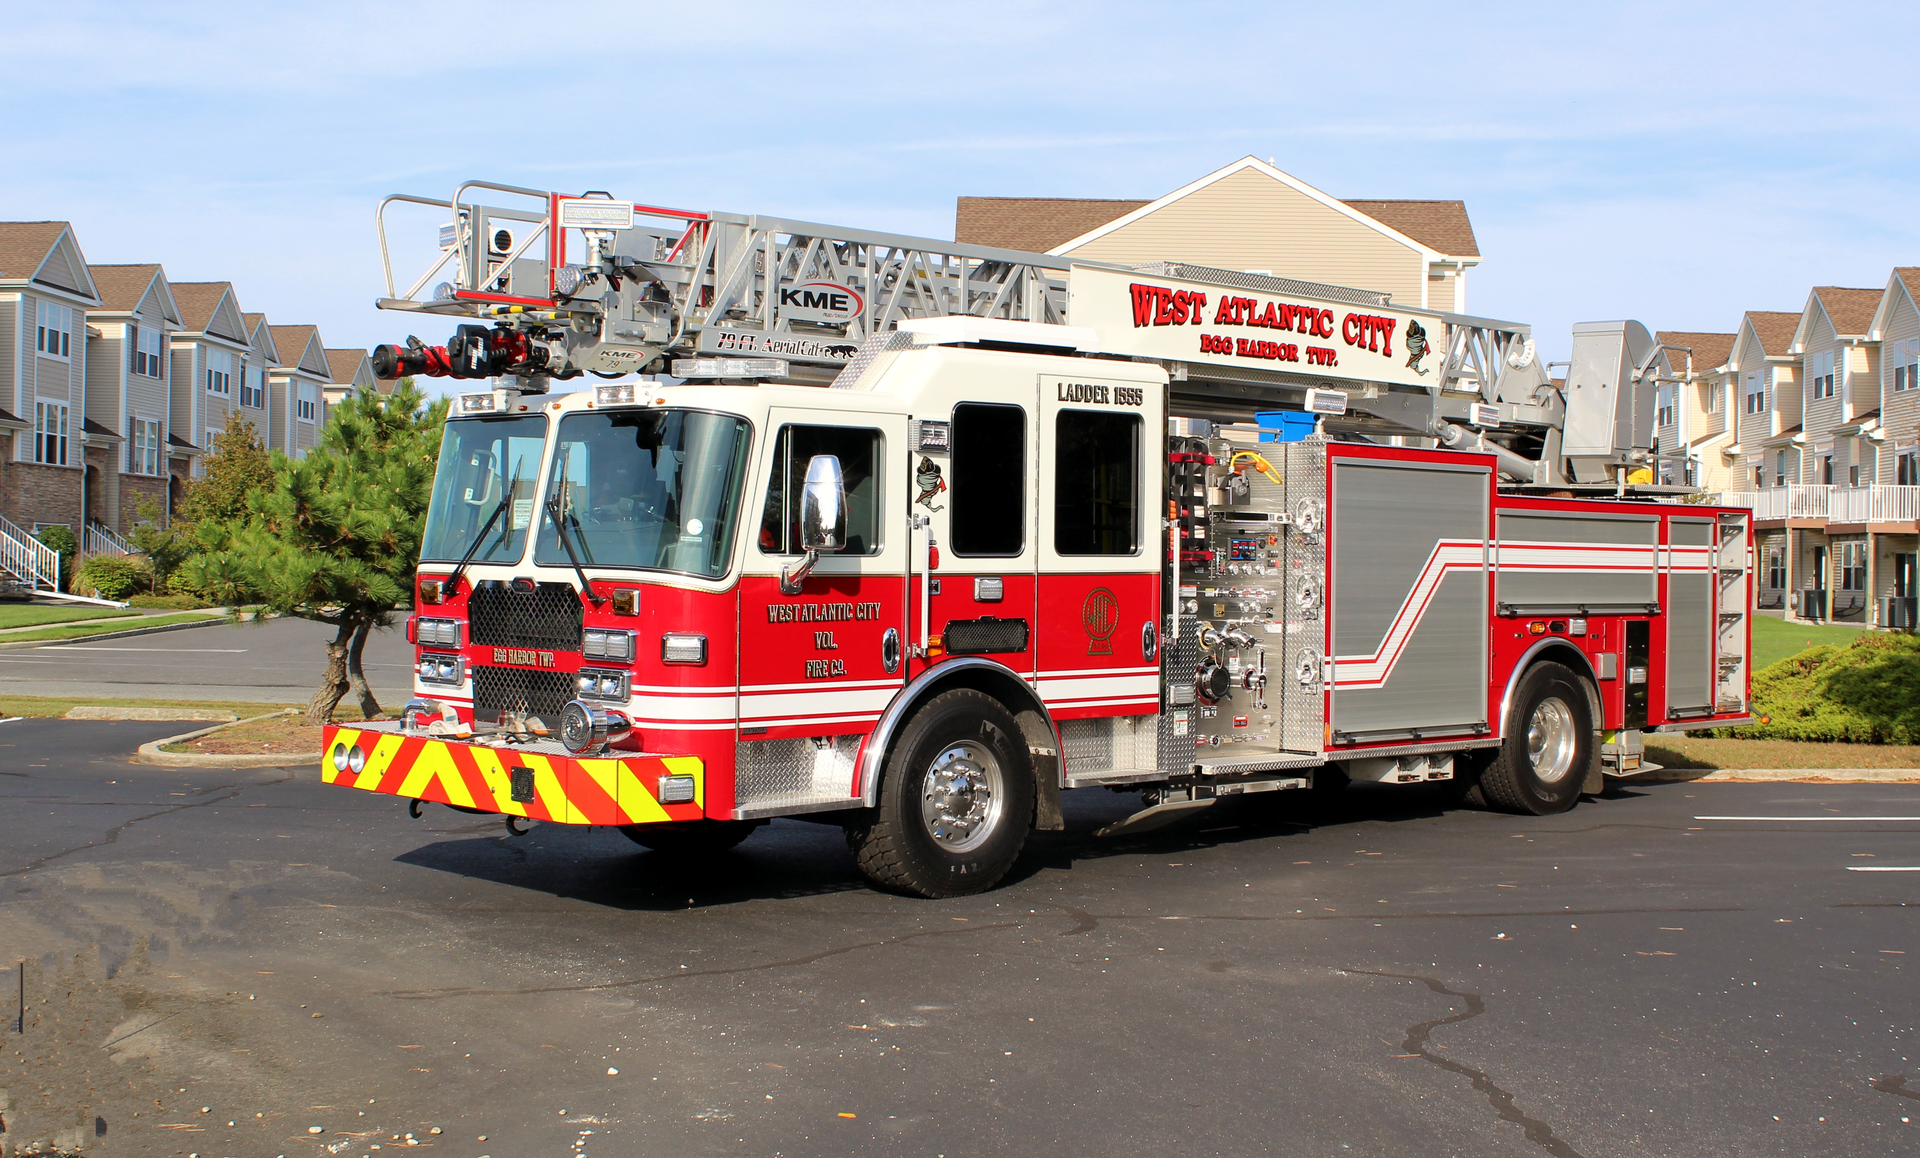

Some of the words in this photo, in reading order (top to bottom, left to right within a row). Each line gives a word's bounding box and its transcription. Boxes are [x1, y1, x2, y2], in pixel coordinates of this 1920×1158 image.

[781, 288, 849, 311] KME
[1130, 284, 1206, 328] WEST
[1214, 295, 1334, 339] ATLANTIC
[1342, 313, 1396, 357] CITY
[717, 332, 736, 350] 79
[738, 335, 757, 351] FT.
[1200, 334, 1233, 354] EGG
[1236, 338, 1299, 362] HARBOR
[1306, 346, 1339, 367] TWP.
[600, 350, 637, 359] KME
[1057, 382, 1110, 404] LADDER
[1113, 386, 1143, 406] 1555
[767, 604, 800, 623] WEST
[801, 603, 853, 622] ATLANTIC
[856, 602, 881, 620] CITY
[815, 631, 838, 650] VOL.
[493, 648, 507, 664] EGG
[508, 649, 537, 666] HARBOR
[538, 651, 556, 668] TWP.
[806, 660, 828, 679] FIRE
